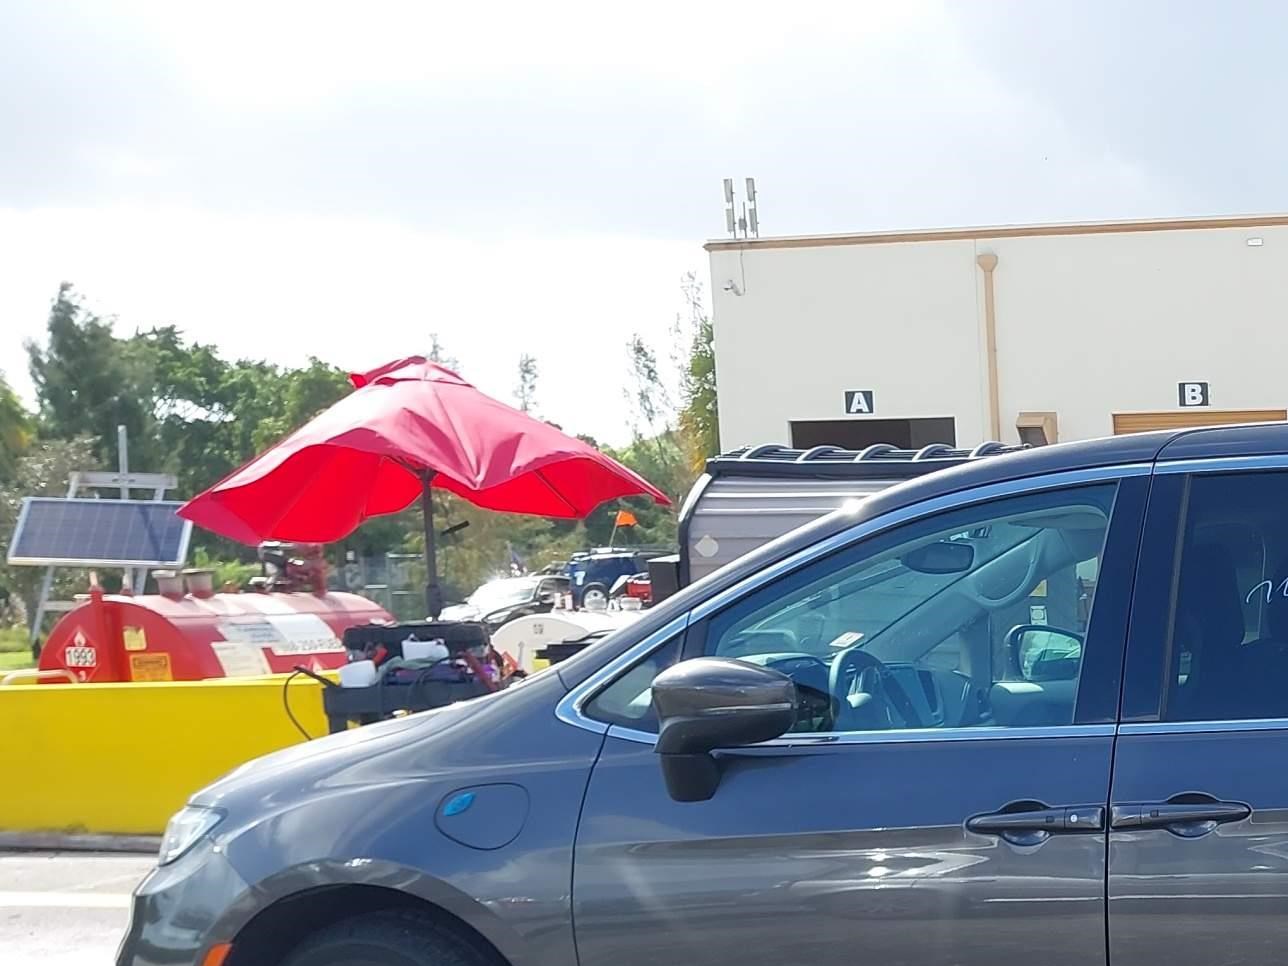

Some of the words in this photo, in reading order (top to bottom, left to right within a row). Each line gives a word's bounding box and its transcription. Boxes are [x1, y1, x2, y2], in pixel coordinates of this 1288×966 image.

[849, 391, 871, 414] A
[1183, 383, 1204, 406] B
[67, 648, 96, 666] 1993
